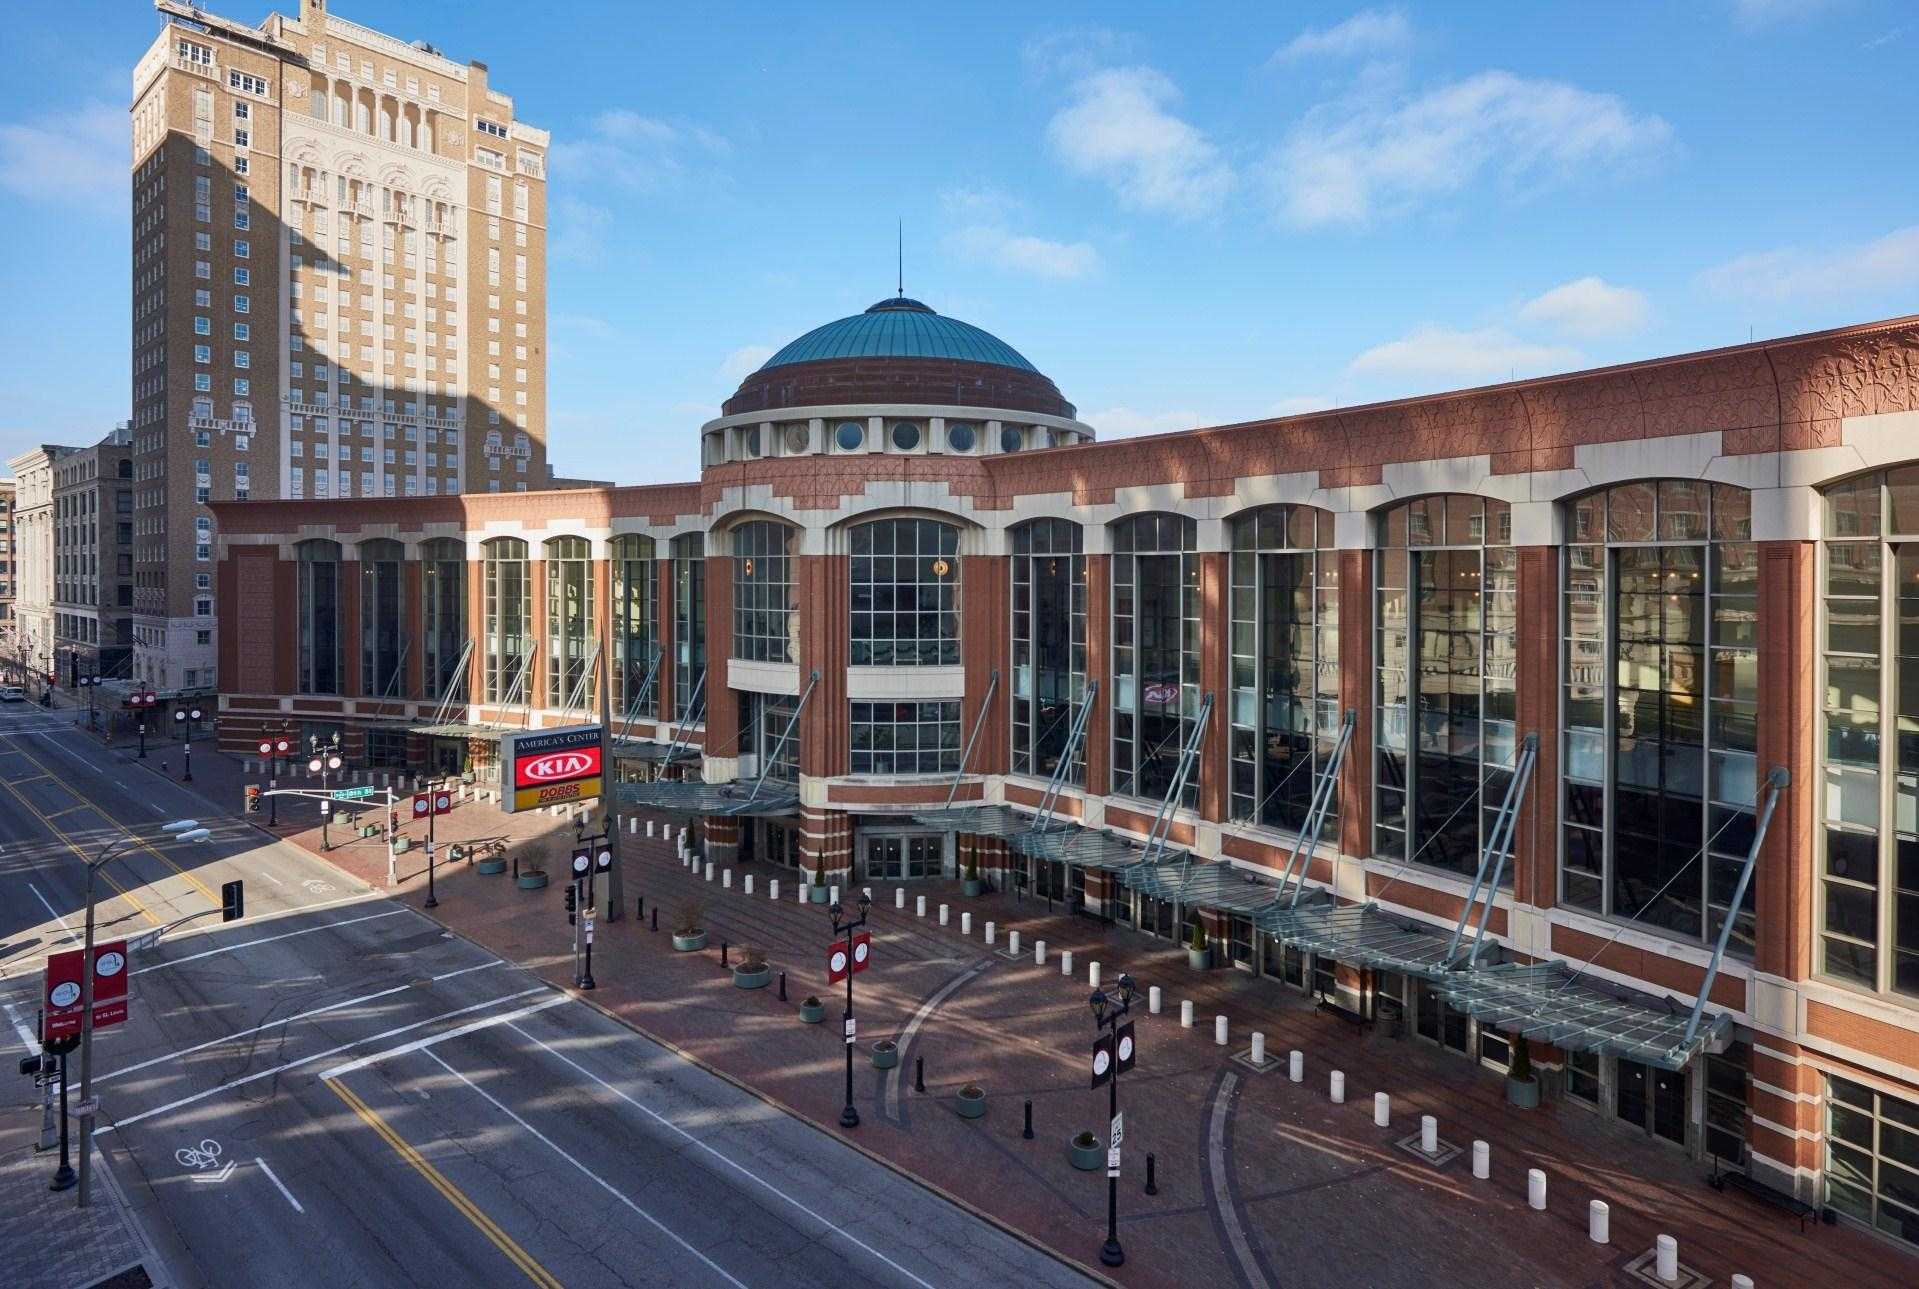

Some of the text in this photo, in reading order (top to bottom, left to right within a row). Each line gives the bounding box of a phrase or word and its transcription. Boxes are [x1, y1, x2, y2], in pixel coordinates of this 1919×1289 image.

[518, 732, 599, 750] AMERICA'S CENTER
[538, 758, 581, 776] KIA
[539, 784, 580, 798] DOBBS
[1112, 1128, 1121, 1145] 25
